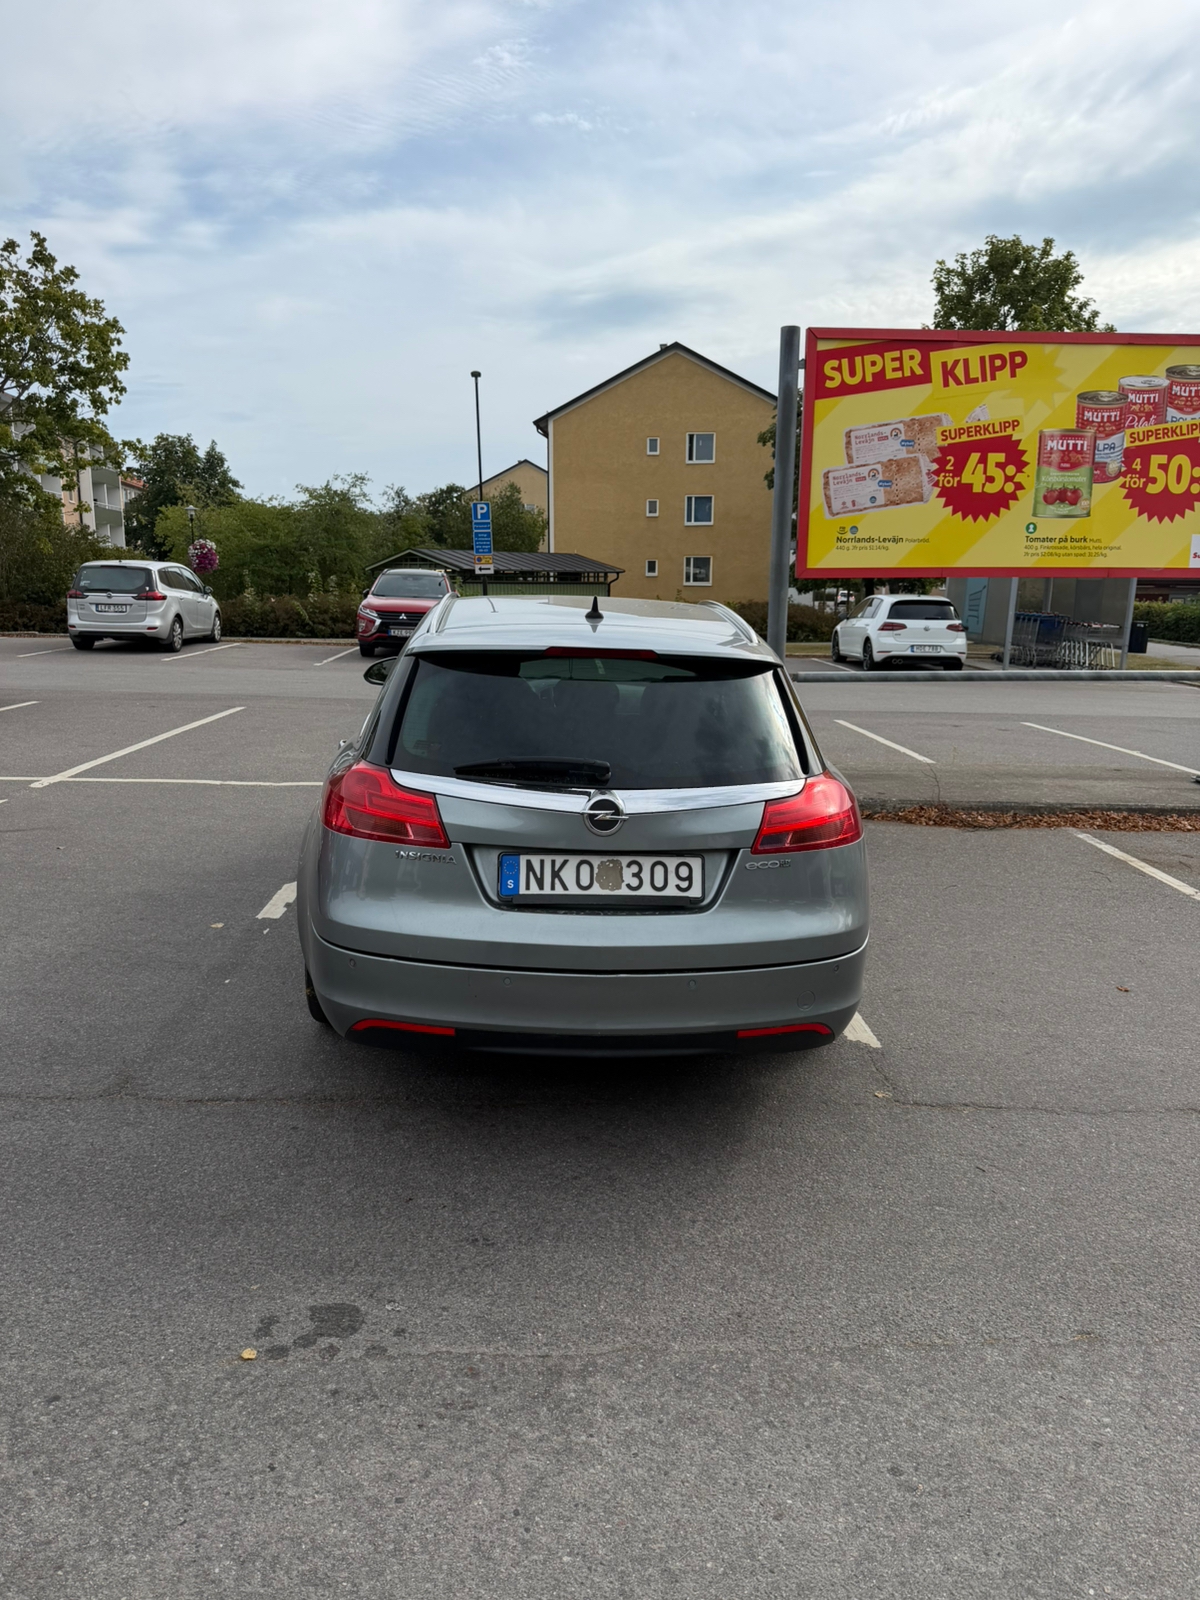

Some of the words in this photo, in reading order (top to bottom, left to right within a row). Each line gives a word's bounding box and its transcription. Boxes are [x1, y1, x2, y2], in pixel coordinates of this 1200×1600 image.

[823, 348, 924, 389] SUPER
[941, 350, 1028, 389] KLIPP
[1128, 393, 1159, 404] MUTTI
[1083, 411, 1120, 422] MUTTI
[940, 419, 1020, 442] SUPERKLIPP
[1046, 439, 1088, 452] MUTTI
[945, 456, 954, 470] 2
[1131, 458, 1142, 471] 4
[938, 472, 960, 487] för
[961, 452, 1016, 494] 45:
[1125, 474, 1146, 488] för
[476, 503, 488, 519] P
[836, 536, 904, 545] Norrlands-Leväjn
[1058, 535, 1068, 544] på
[395, 850, 457, 865] INSIGNIA
[525, 859, 594, 892] NKO
[625, 859, 693, 893] 309
[507, 879, 514, 889] S
